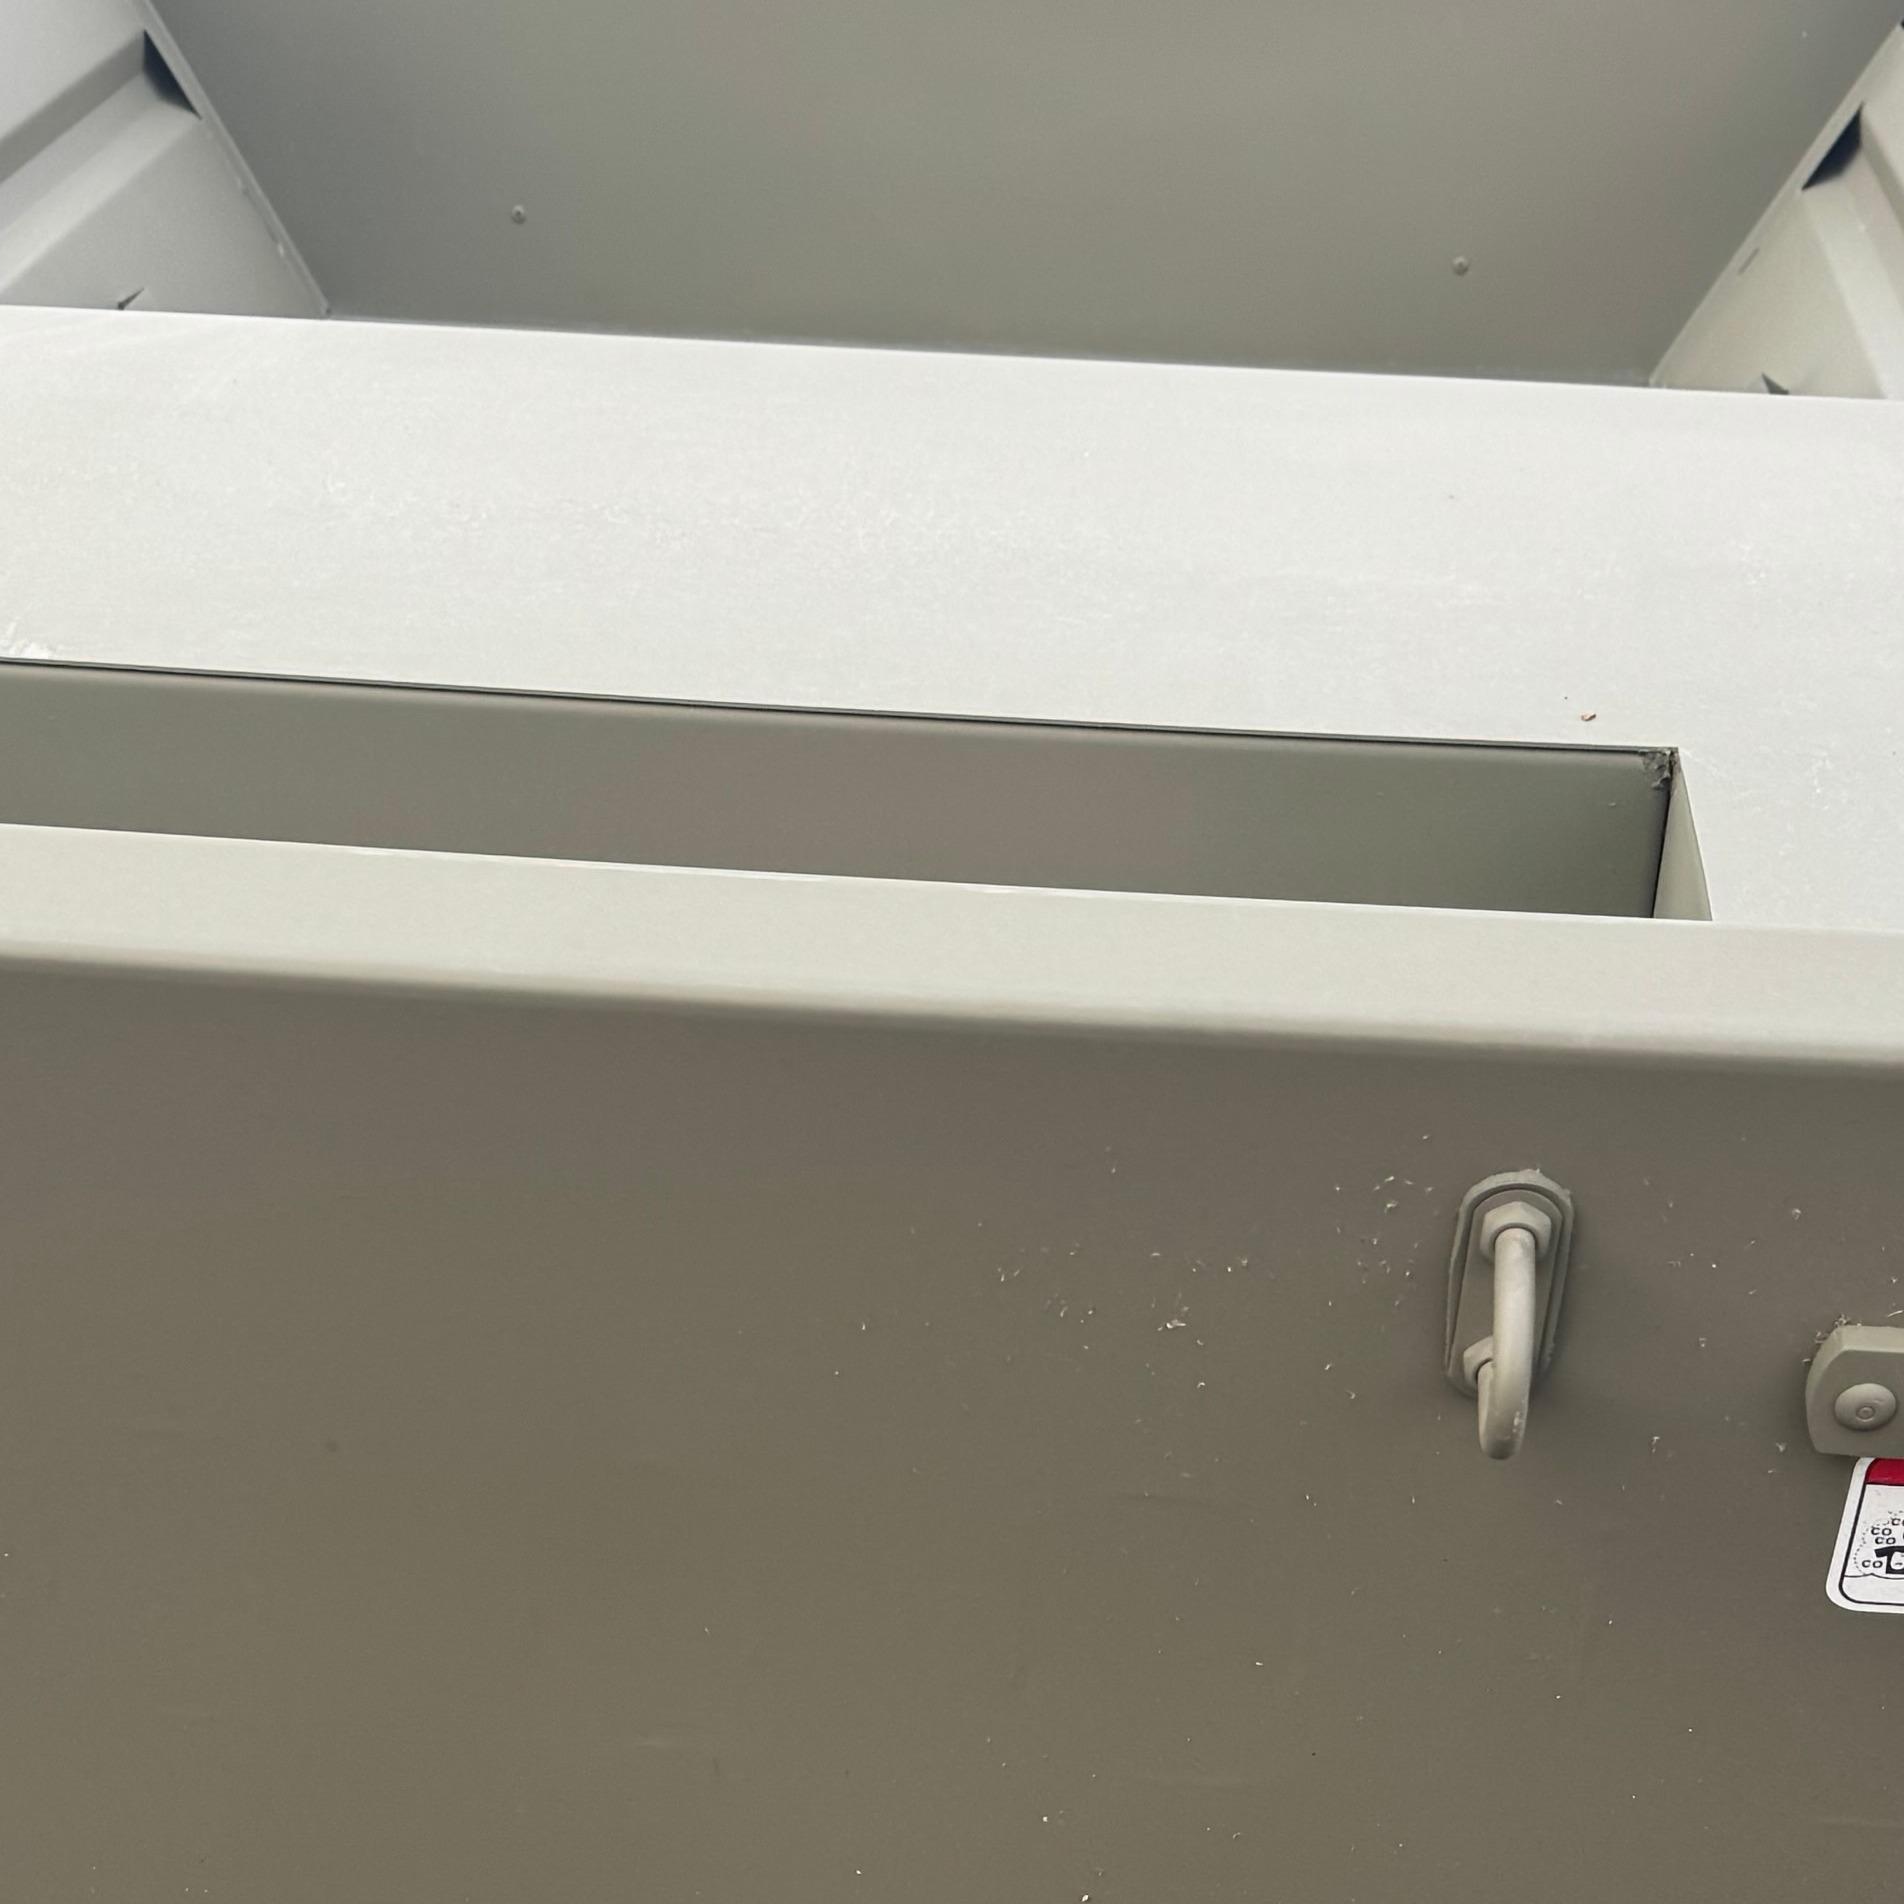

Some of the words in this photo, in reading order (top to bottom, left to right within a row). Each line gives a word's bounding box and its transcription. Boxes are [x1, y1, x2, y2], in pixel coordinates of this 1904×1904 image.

[1871, 1526, 1892, 1536] CO
[1875, 1536, 1897, 1545] CO
[1861, 1559, 1883, 1569] CO
